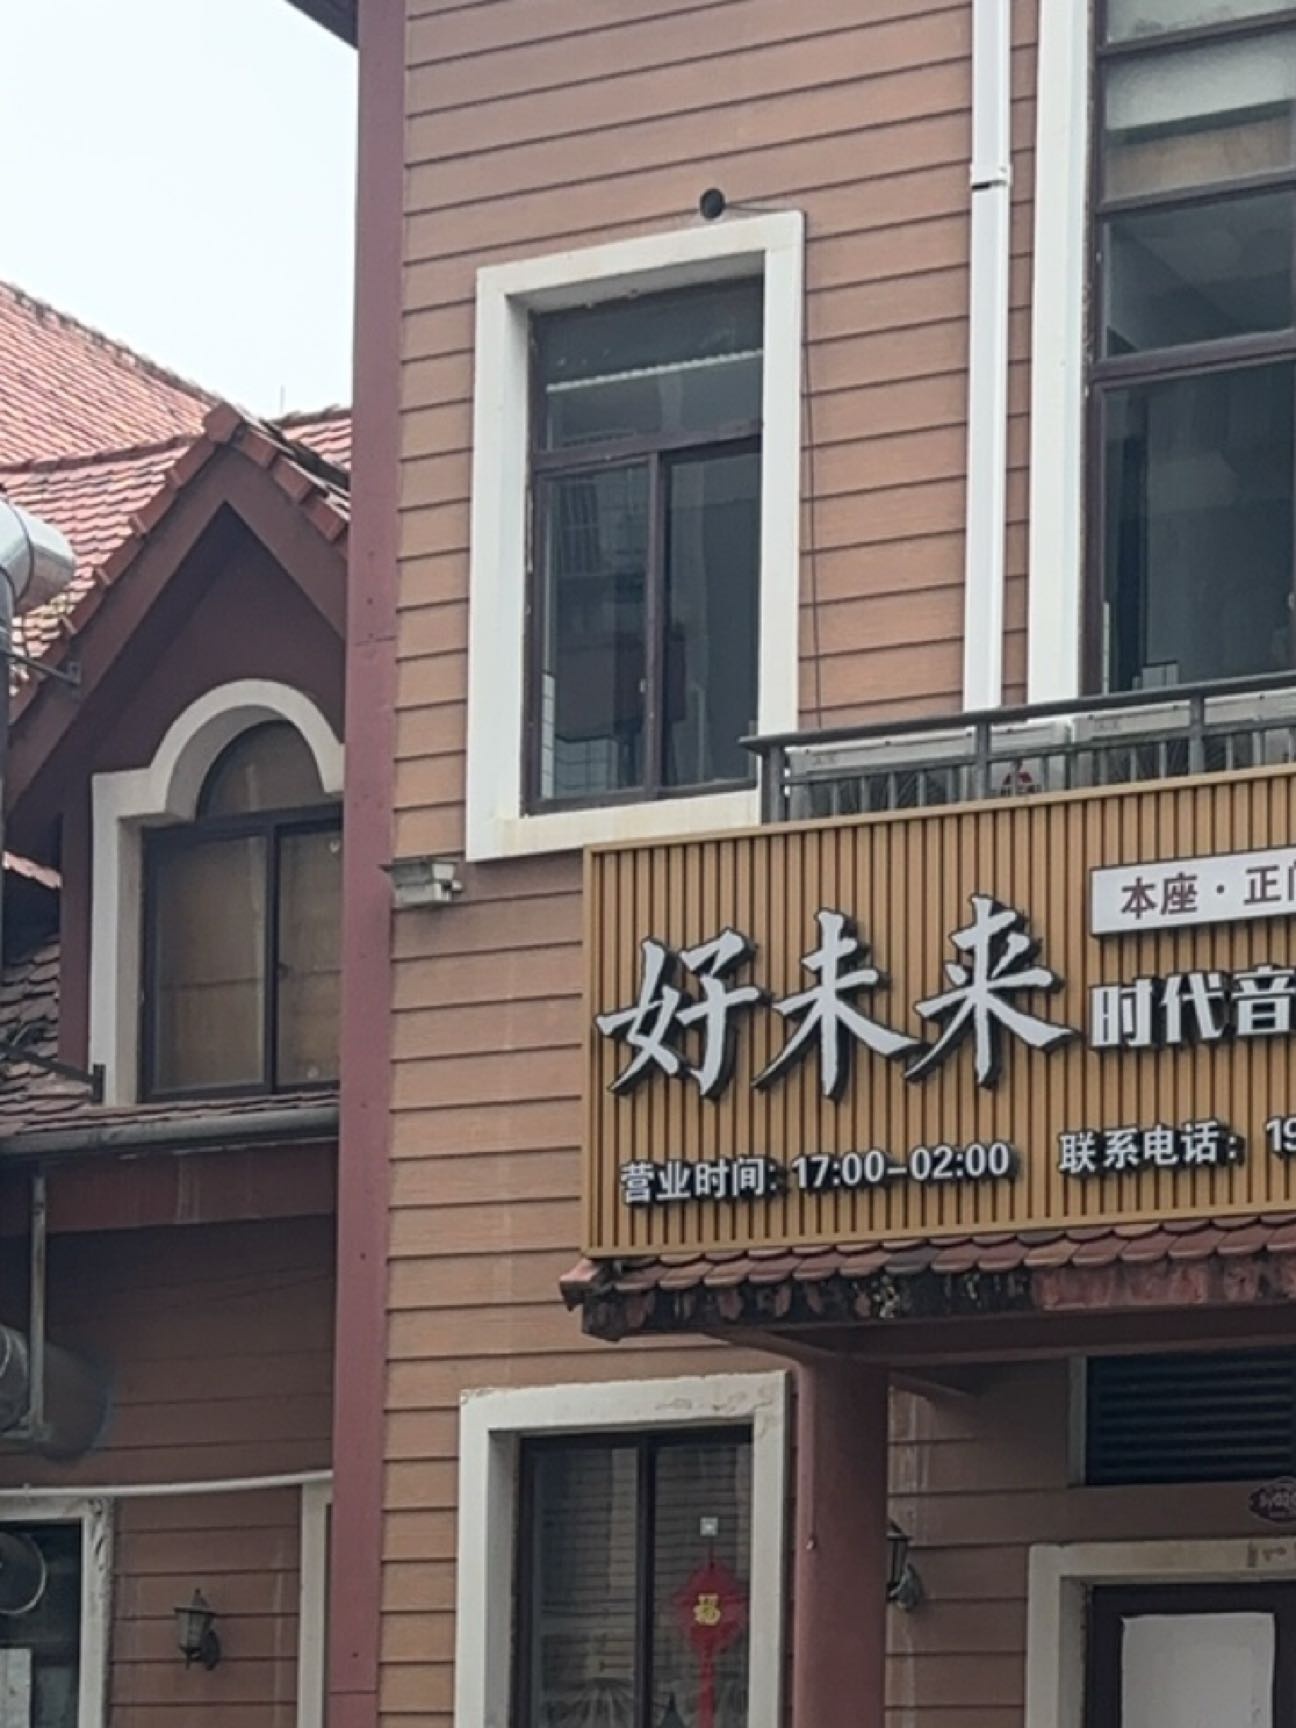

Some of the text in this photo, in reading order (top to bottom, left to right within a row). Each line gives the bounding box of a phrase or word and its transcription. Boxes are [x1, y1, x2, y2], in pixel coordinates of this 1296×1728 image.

[594, 892, 1078, 1099] 好未来
[1058, 1119, 1241, 1175] 联系电话：
